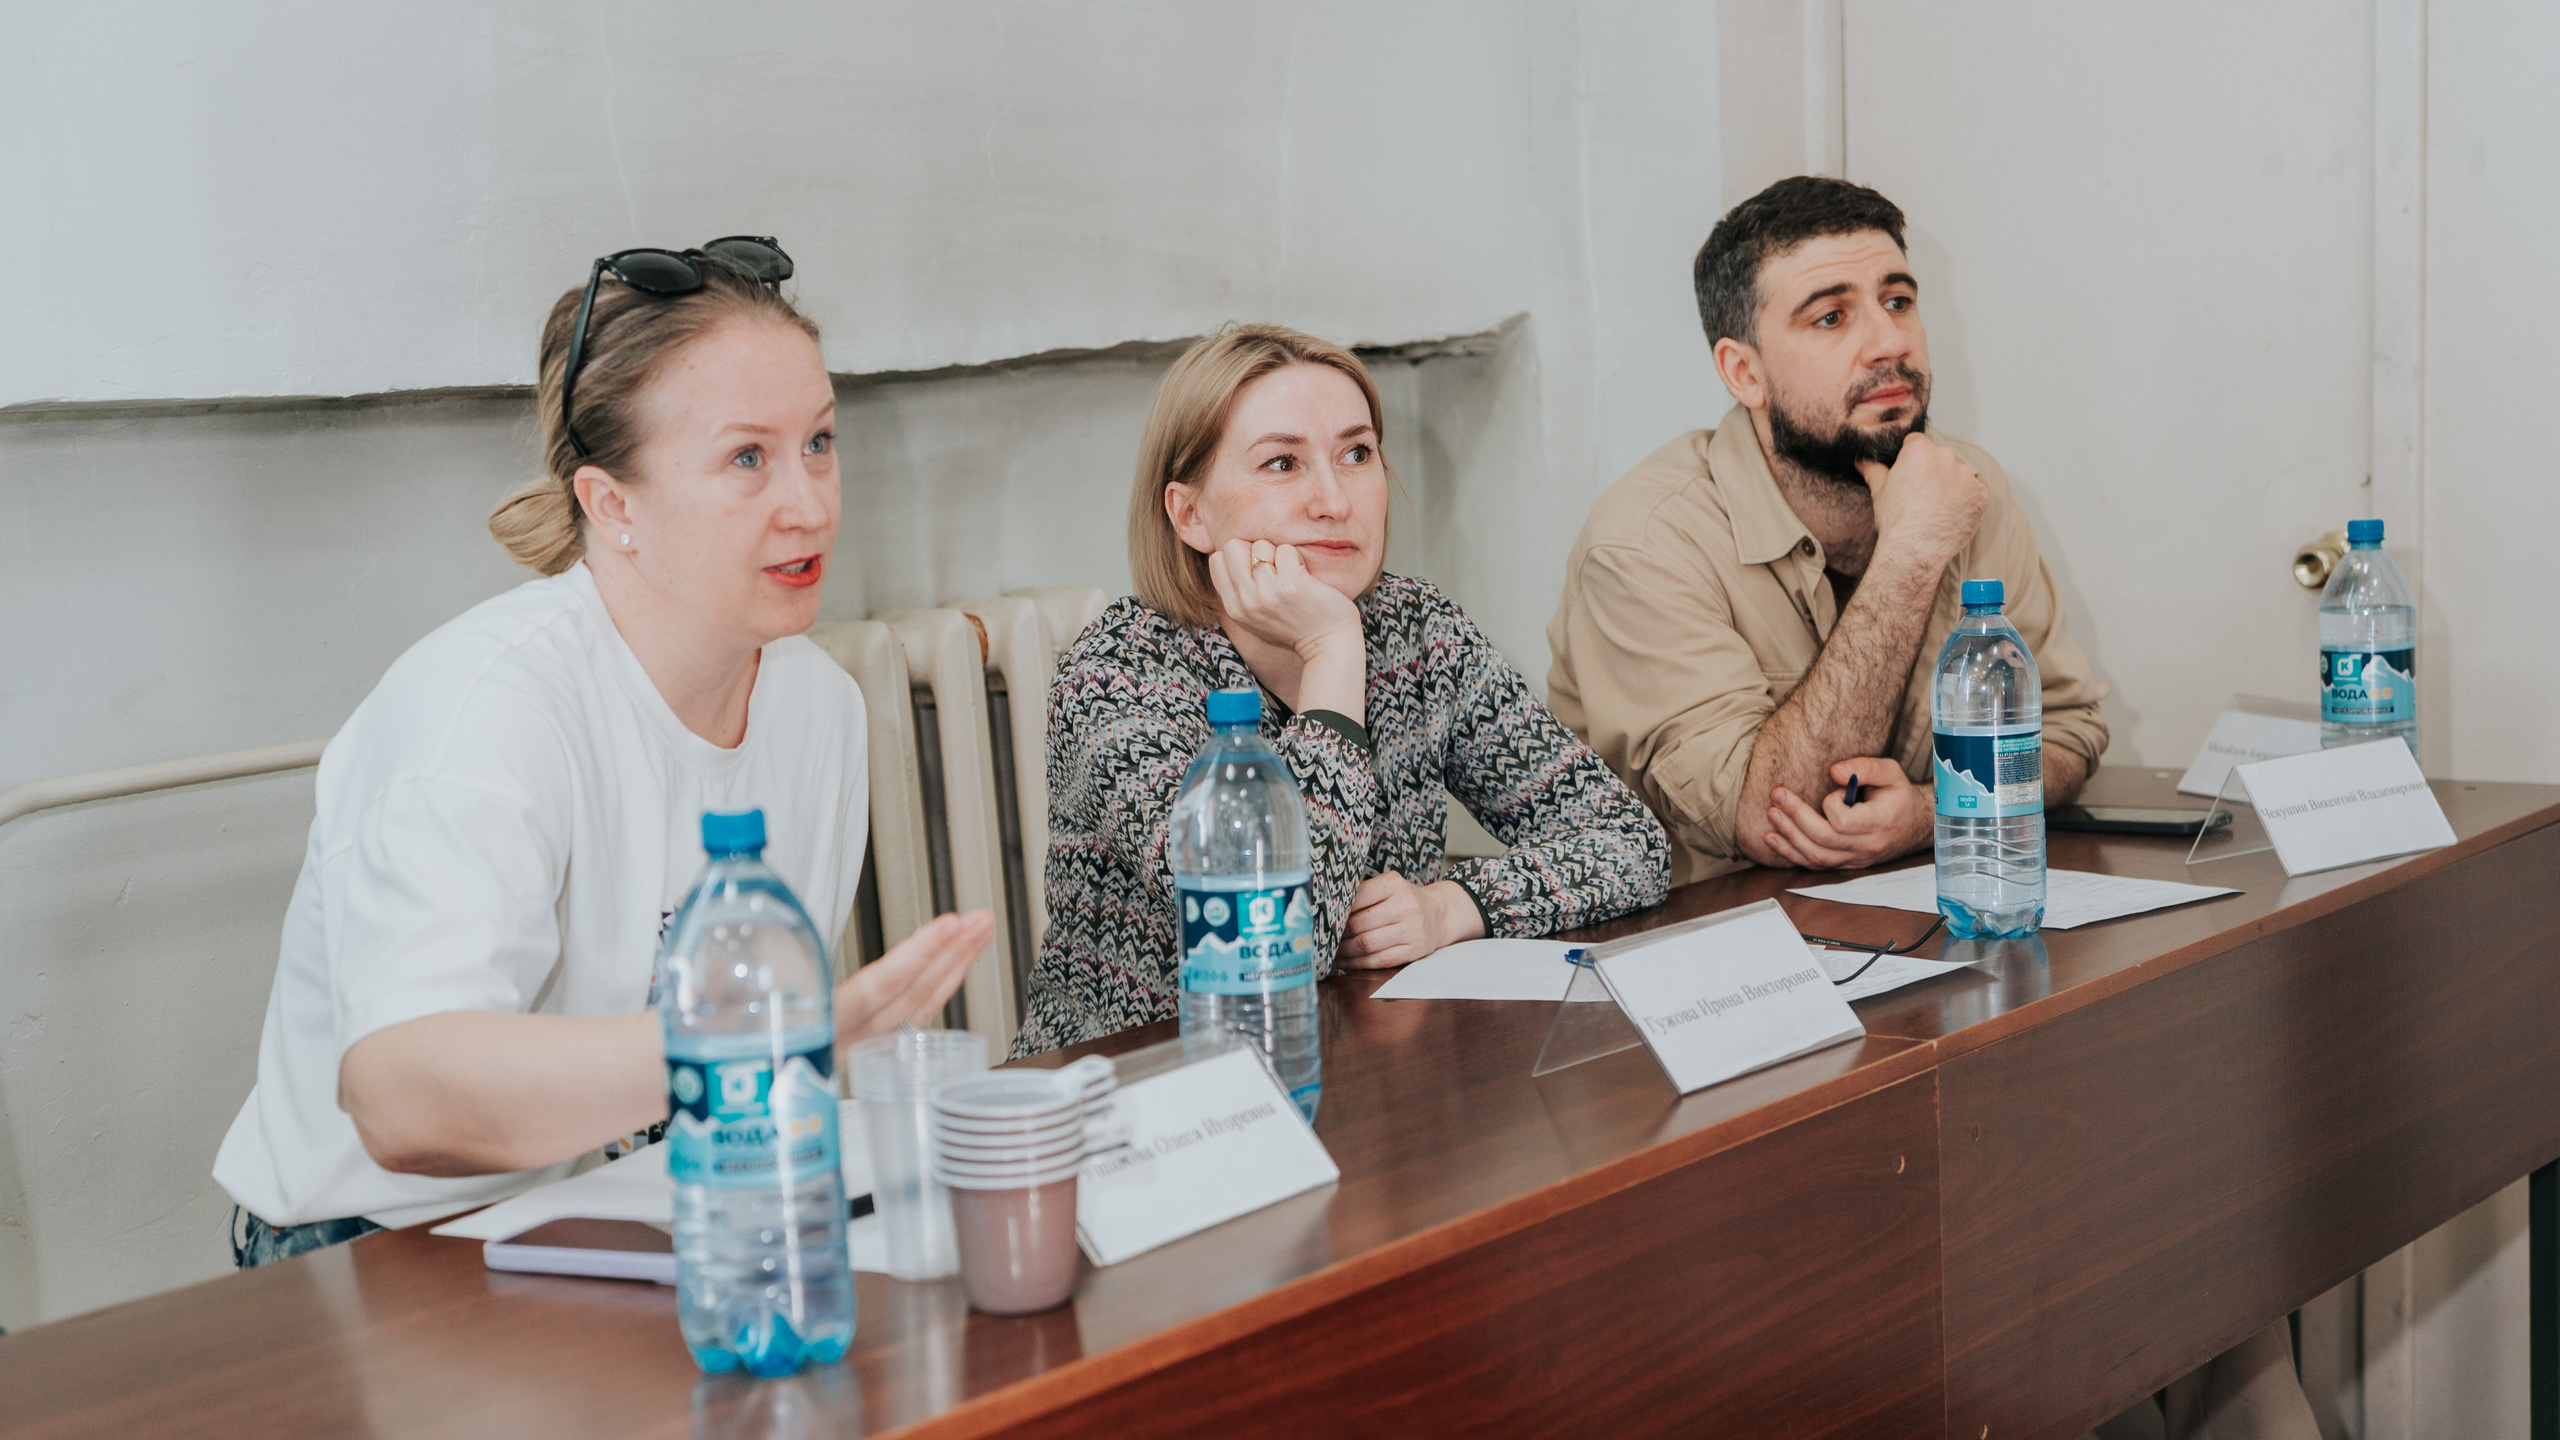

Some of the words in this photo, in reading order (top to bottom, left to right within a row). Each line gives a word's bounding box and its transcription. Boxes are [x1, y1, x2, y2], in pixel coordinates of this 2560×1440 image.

[2331, 688, 2368, 702] ВОДА
[2308, 792, 2358, 811] Викентий
[1240, 942, 1292, 959] ВОДА
[1643, 1005, 1699, 1035] Гужова
[1697, 993, 1744, 1017] Ирина
[1740, 967, 1820, 1001] Викторовна
[1152, 1127, 1203, 1154] Олеся
[1200, 1102, 1276, 1140] Игоревна
